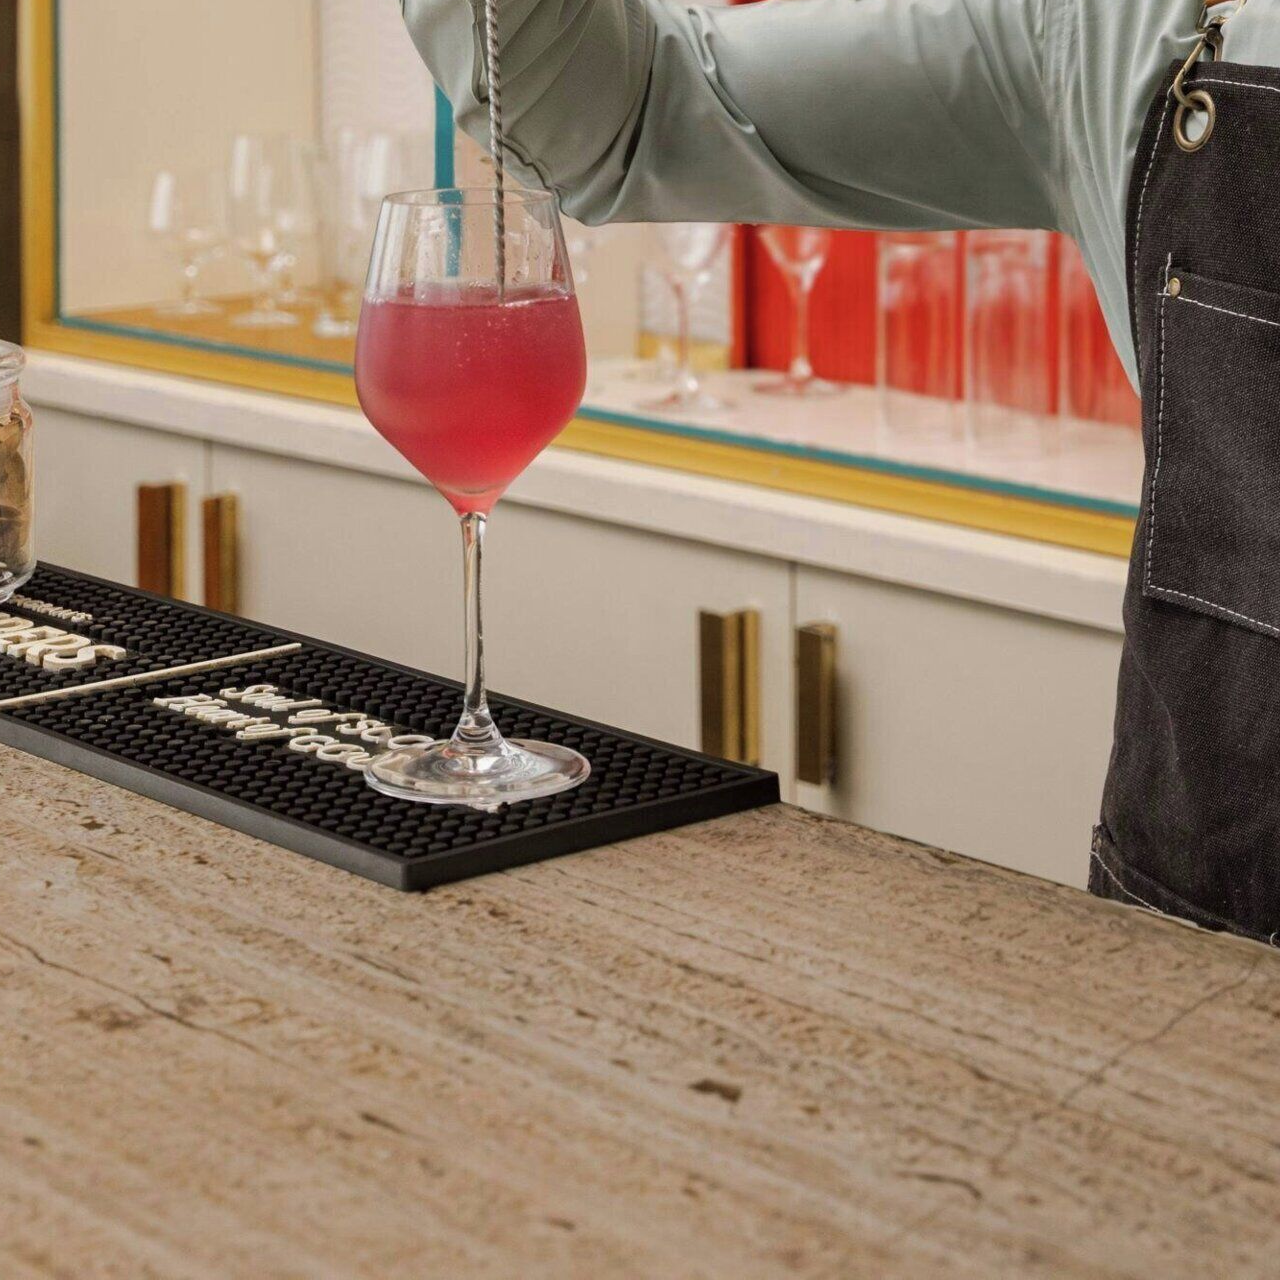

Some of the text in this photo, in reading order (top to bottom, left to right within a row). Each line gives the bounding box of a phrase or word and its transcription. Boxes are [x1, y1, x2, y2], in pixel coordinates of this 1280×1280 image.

[152, 693, 272, 730] Heart
[235, 723, 319, 741] of
[218, 683, 368, 725] Soul of
